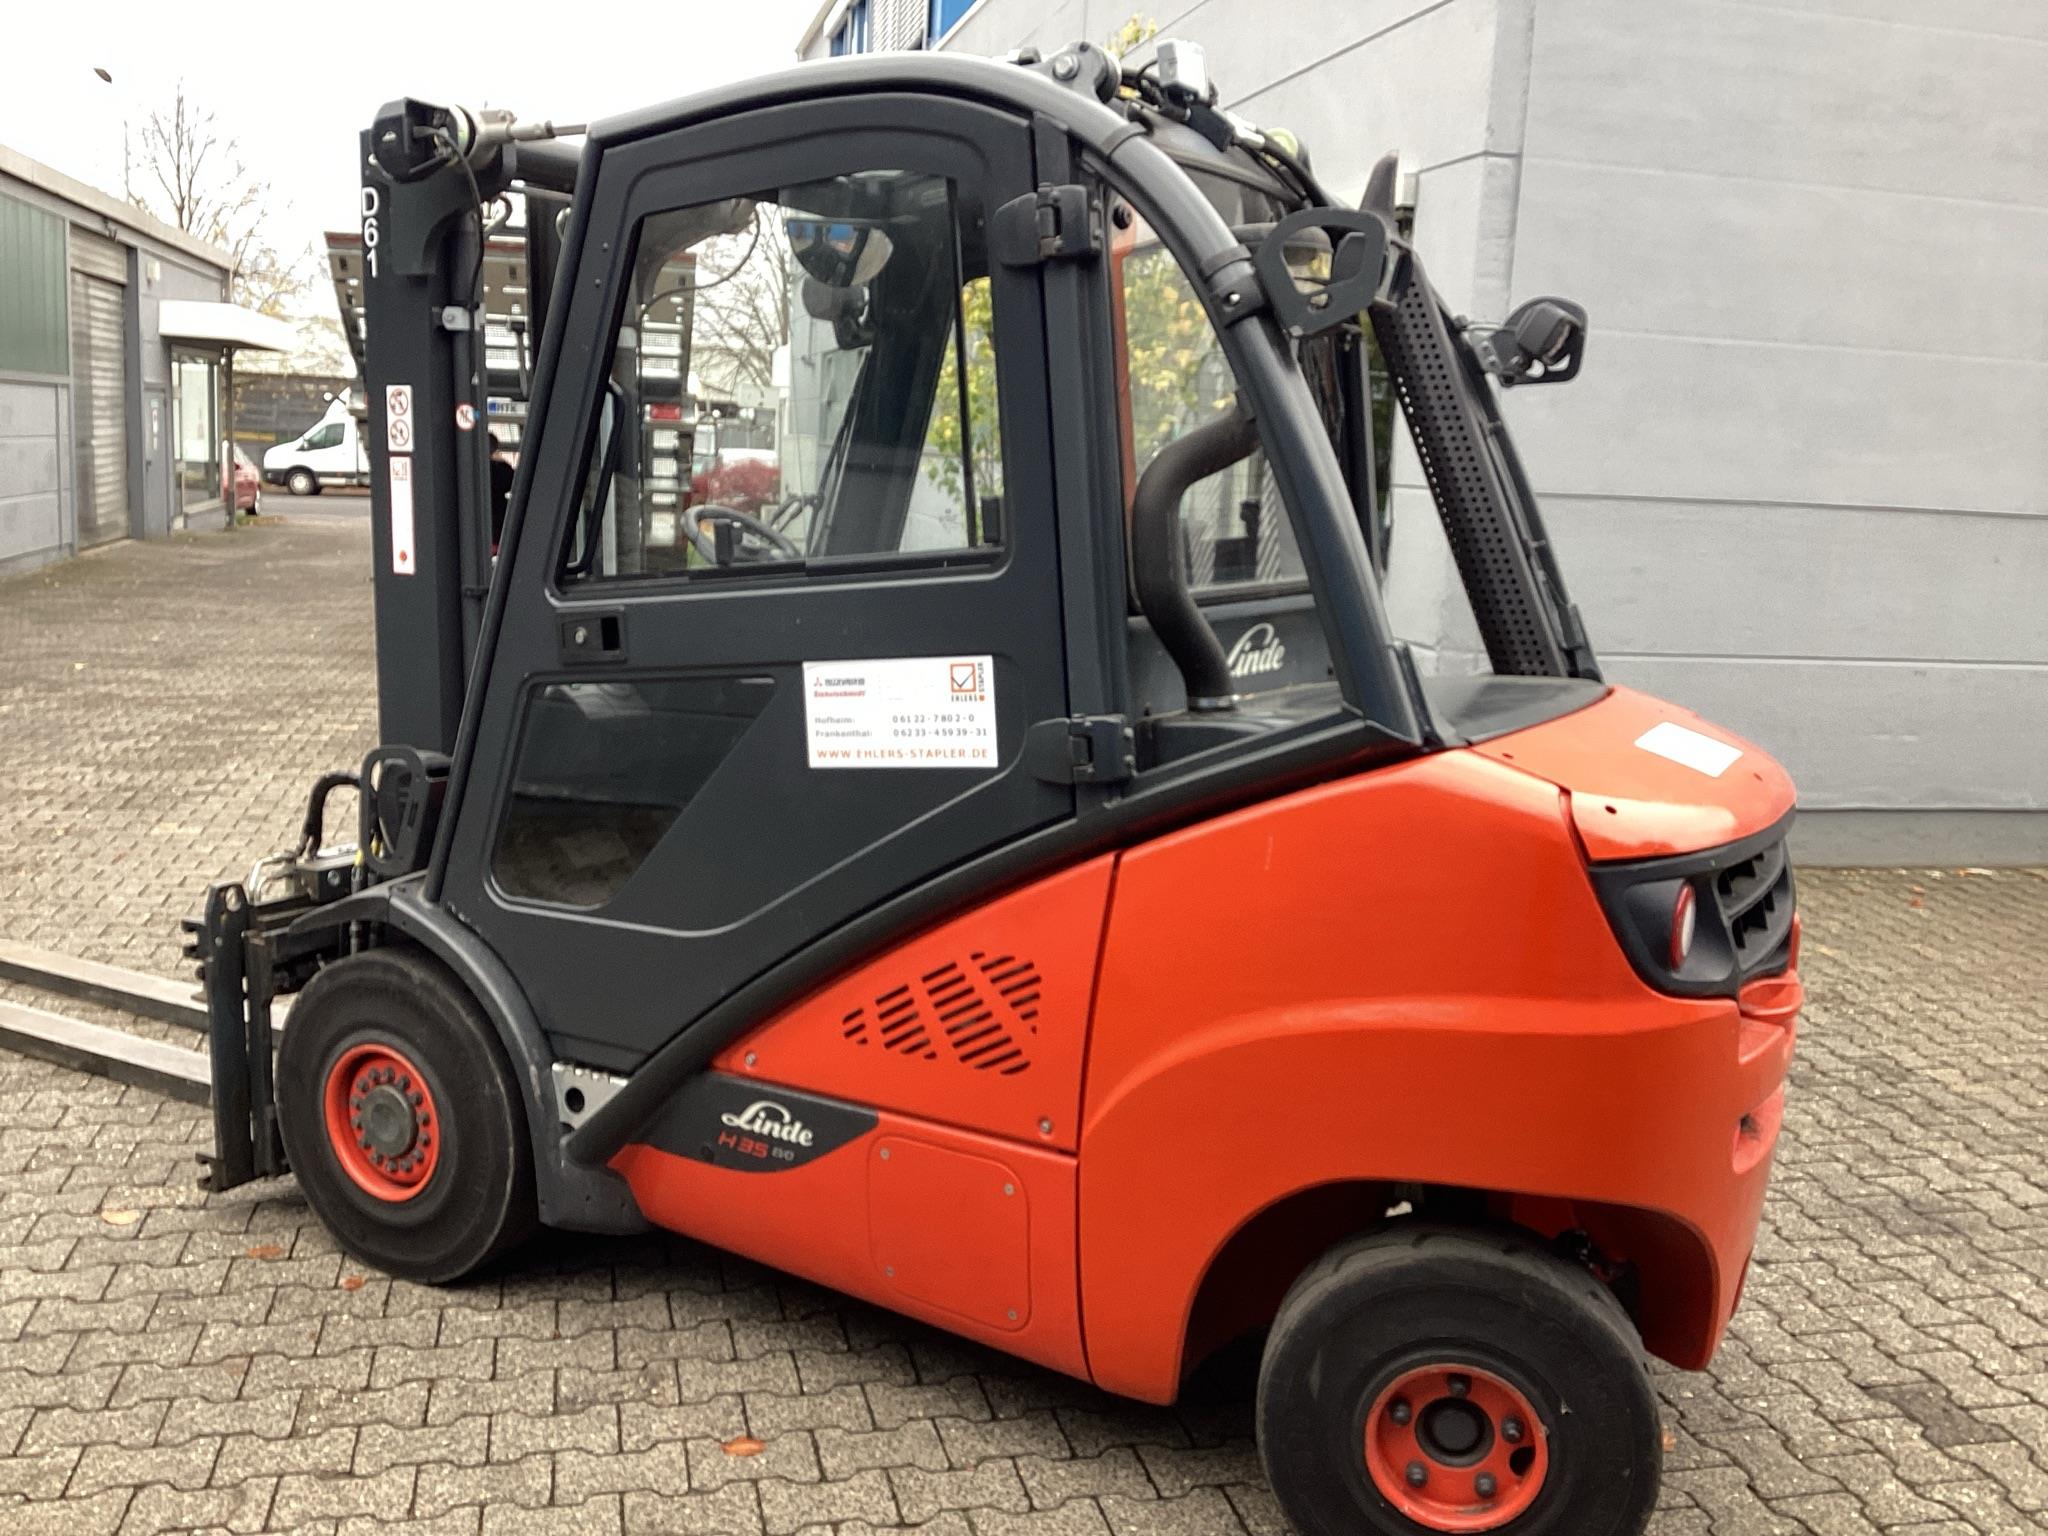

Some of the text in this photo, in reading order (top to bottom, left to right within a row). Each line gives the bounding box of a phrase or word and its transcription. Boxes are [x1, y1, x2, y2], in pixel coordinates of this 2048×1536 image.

[361, 186, 380, 279] D61
[1226, 622, 1286, 679] Linde
[721, 1100, 814, 1147] Linde
